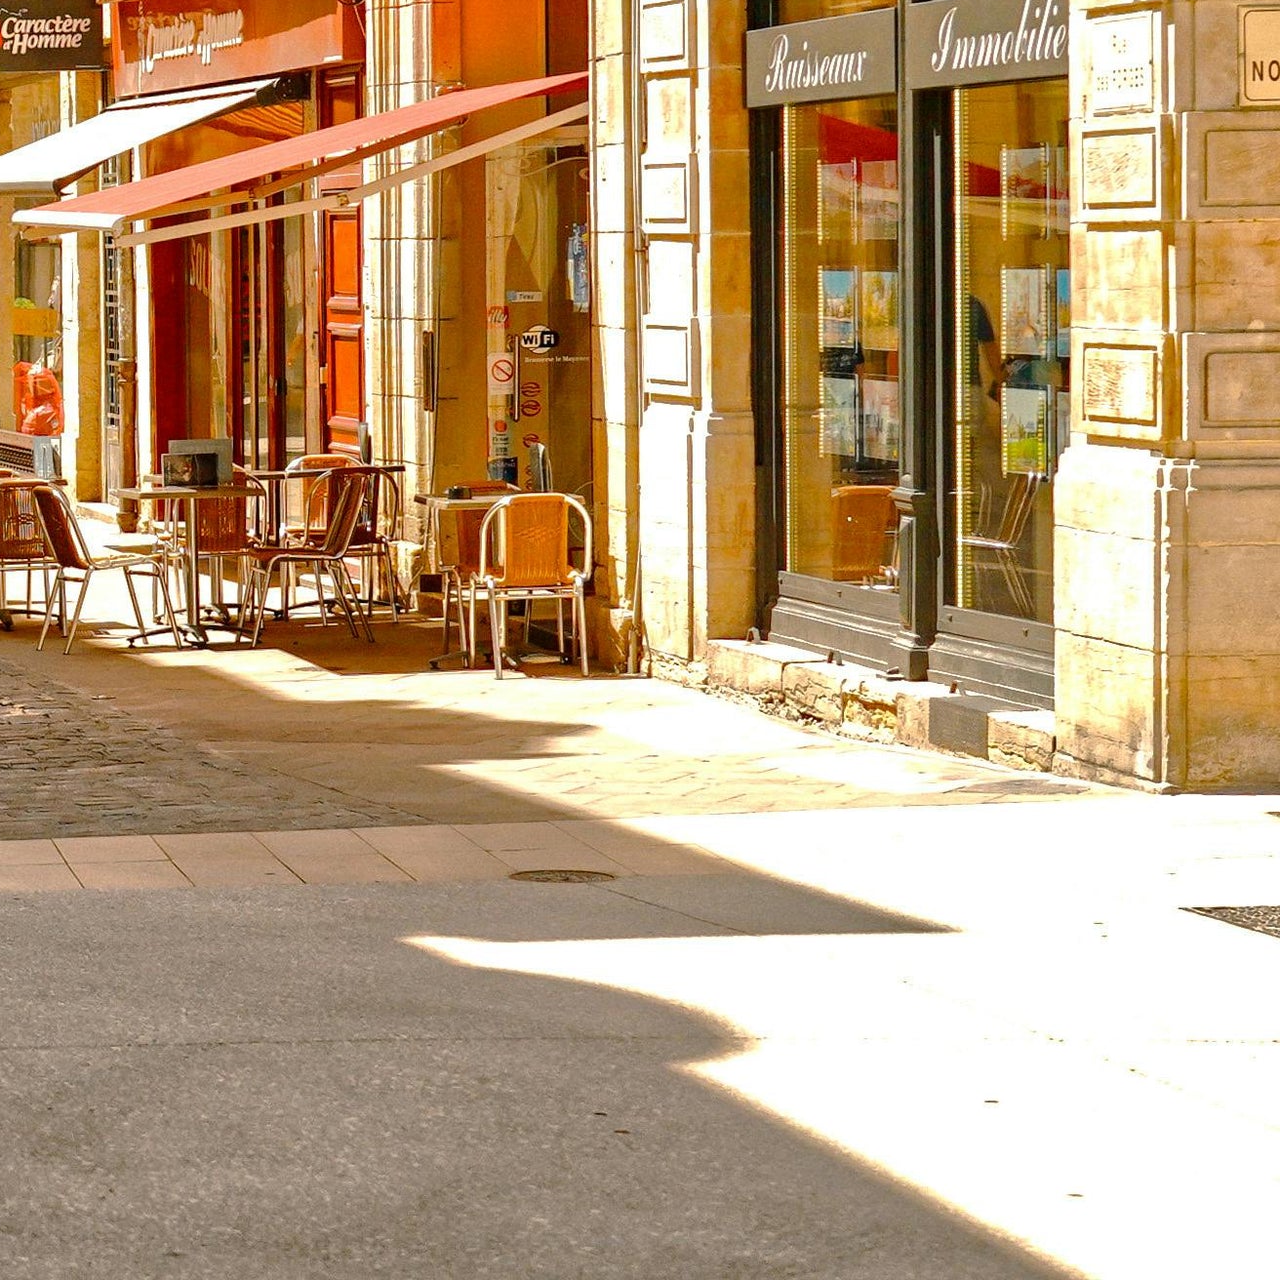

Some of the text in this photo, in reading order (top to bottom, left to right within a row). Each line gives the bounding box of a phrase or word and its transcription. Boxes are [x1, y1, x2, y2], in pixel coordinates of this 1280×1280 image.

[0, 14, 91, 39] Caractère
[2, 32, 83, 55] d'Homme
[765, 33, 867, 93] Ruisseaux
